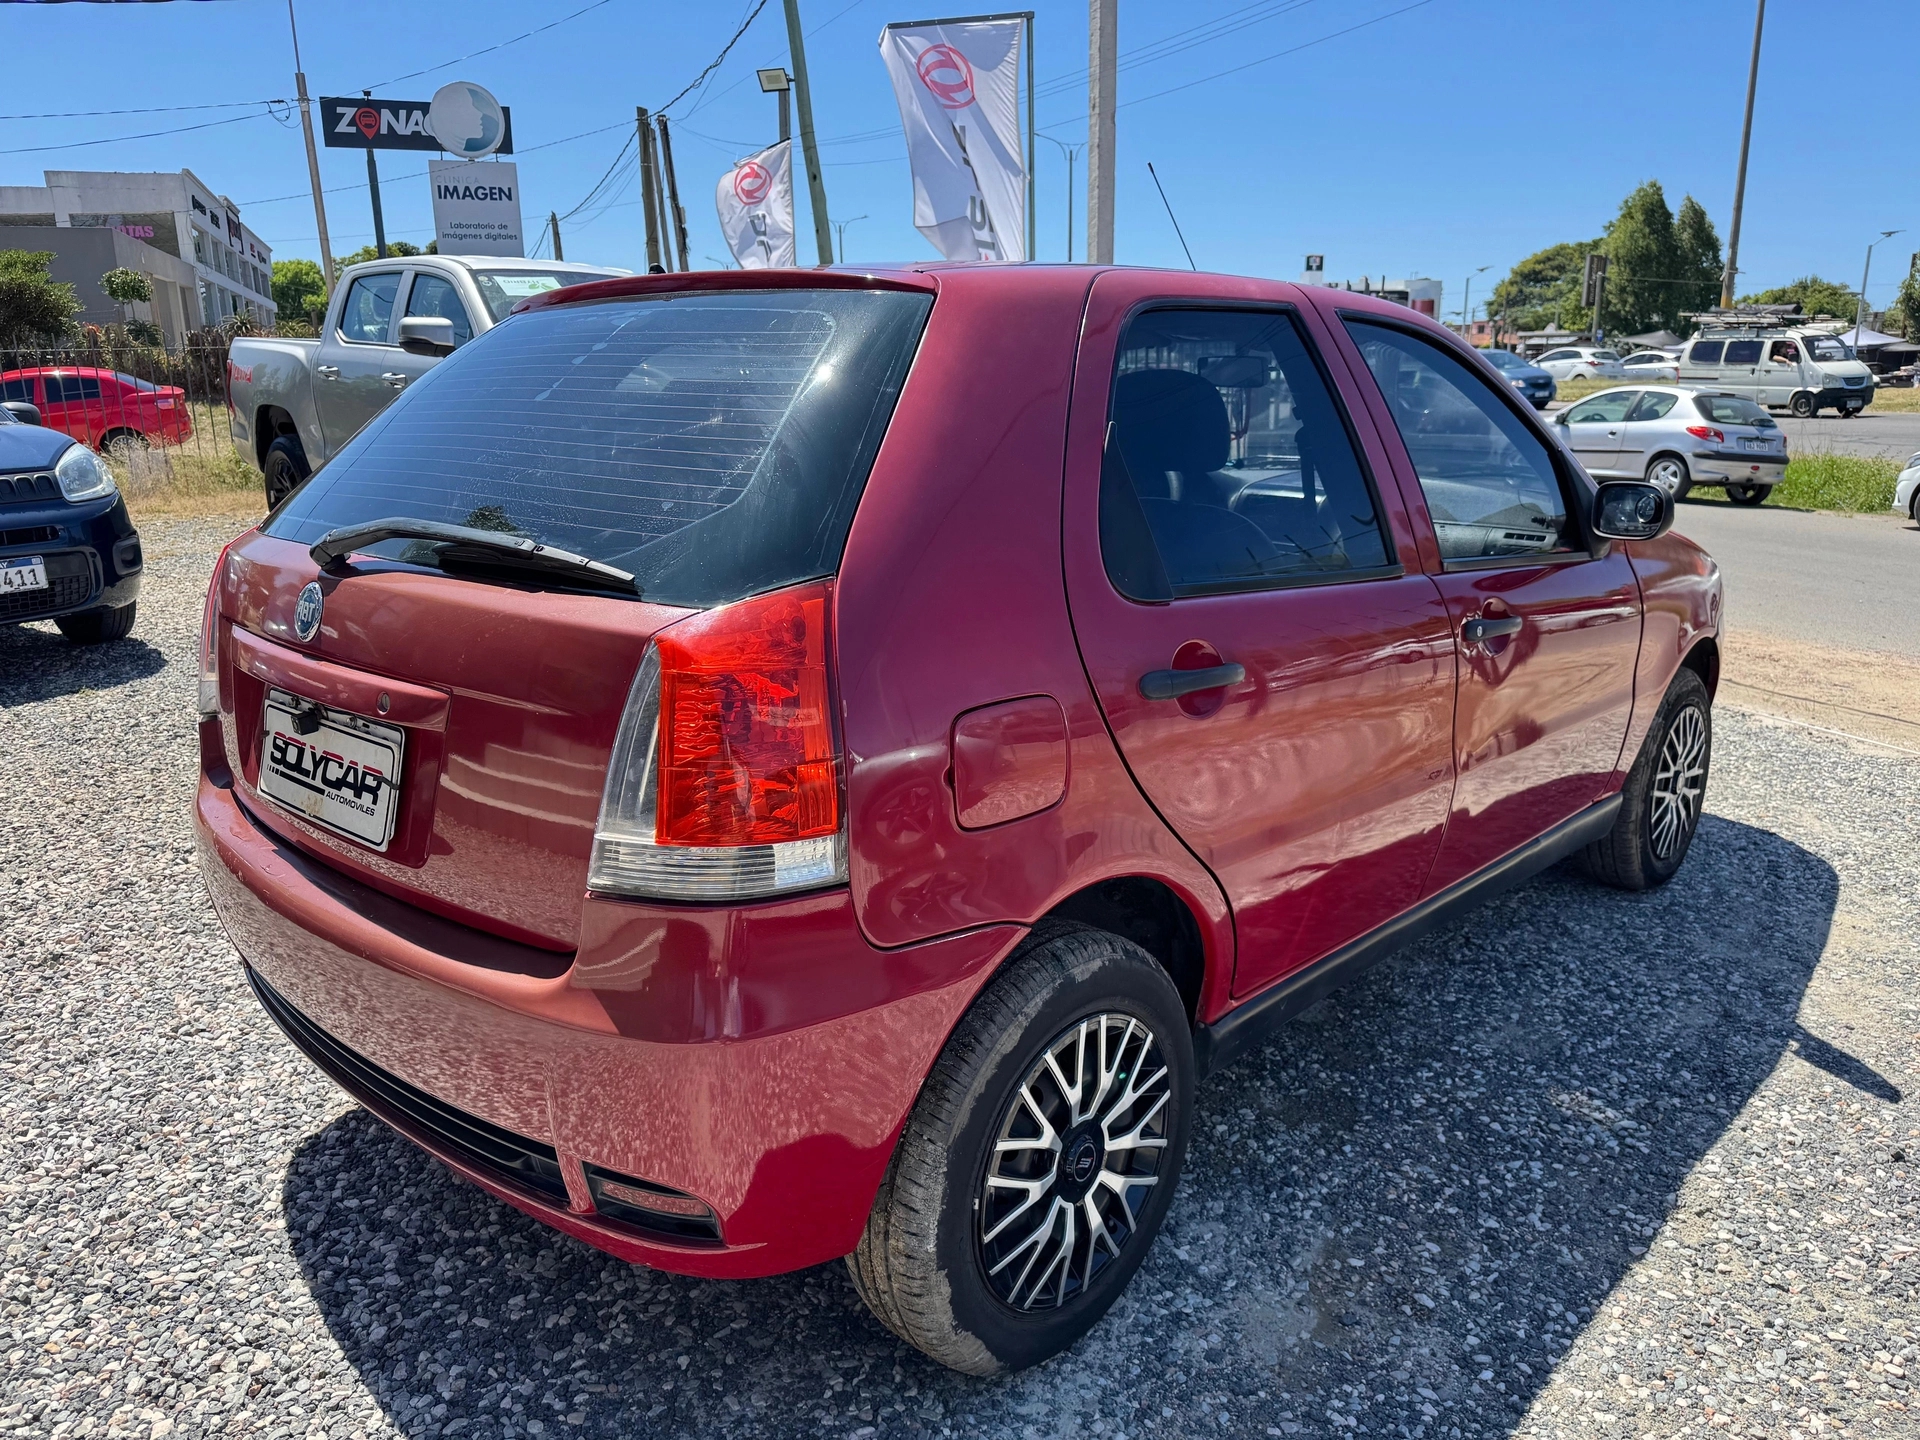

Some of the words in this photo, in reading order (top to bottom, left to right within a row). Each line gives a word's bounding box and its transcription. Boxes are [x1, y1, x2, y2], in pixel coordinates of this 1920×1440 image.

[437, 185, 513, 201] IMAGEN
[450, 222, 496, 230] Laboratorio
[497, 223, 509, 231] de
[442, 231, 482, 241] imágenes
[484, 232, 518, 242] digitales
[270, 731, 384, 806] SOLYCAR
[325, 790, 376, 817] AUTOMOVILES
